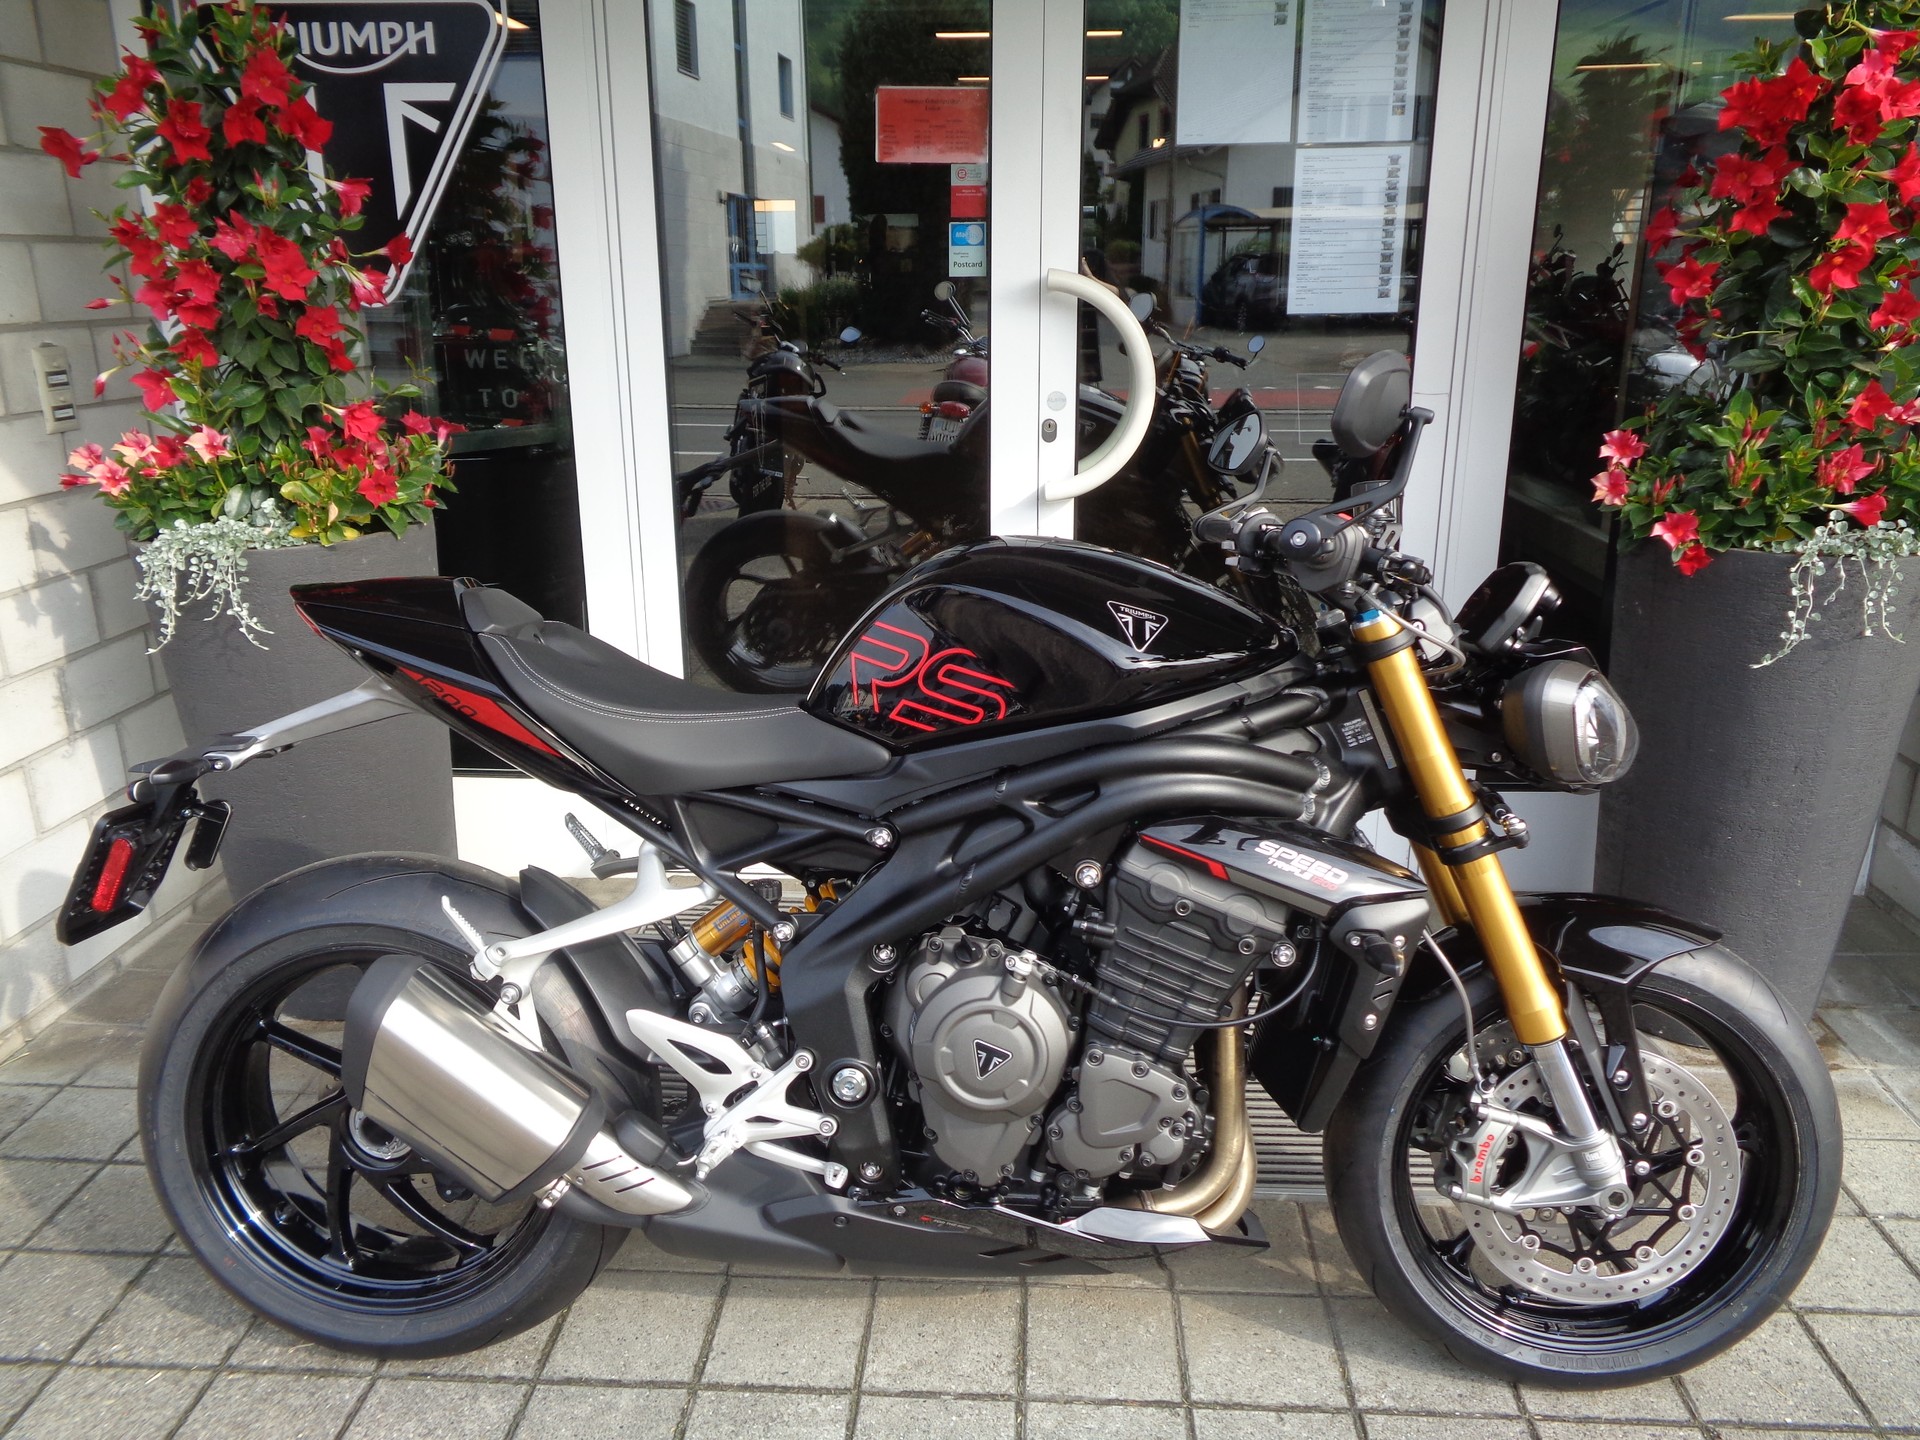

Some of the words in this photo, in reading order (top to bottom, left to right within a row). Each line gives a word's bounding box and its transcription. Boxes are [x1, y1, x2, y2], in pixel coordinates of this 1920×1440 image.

[272, 20, 436, 58] IUMPH
[953, 260, 983, 268] Postcard
[1119, 605, 1156, 621] TRIUMPH
[850, 620, 1016, 732] RS
[1254, 840, 1349, 885] SPEED
[1469, 1134, 1495, 1184] brembo
